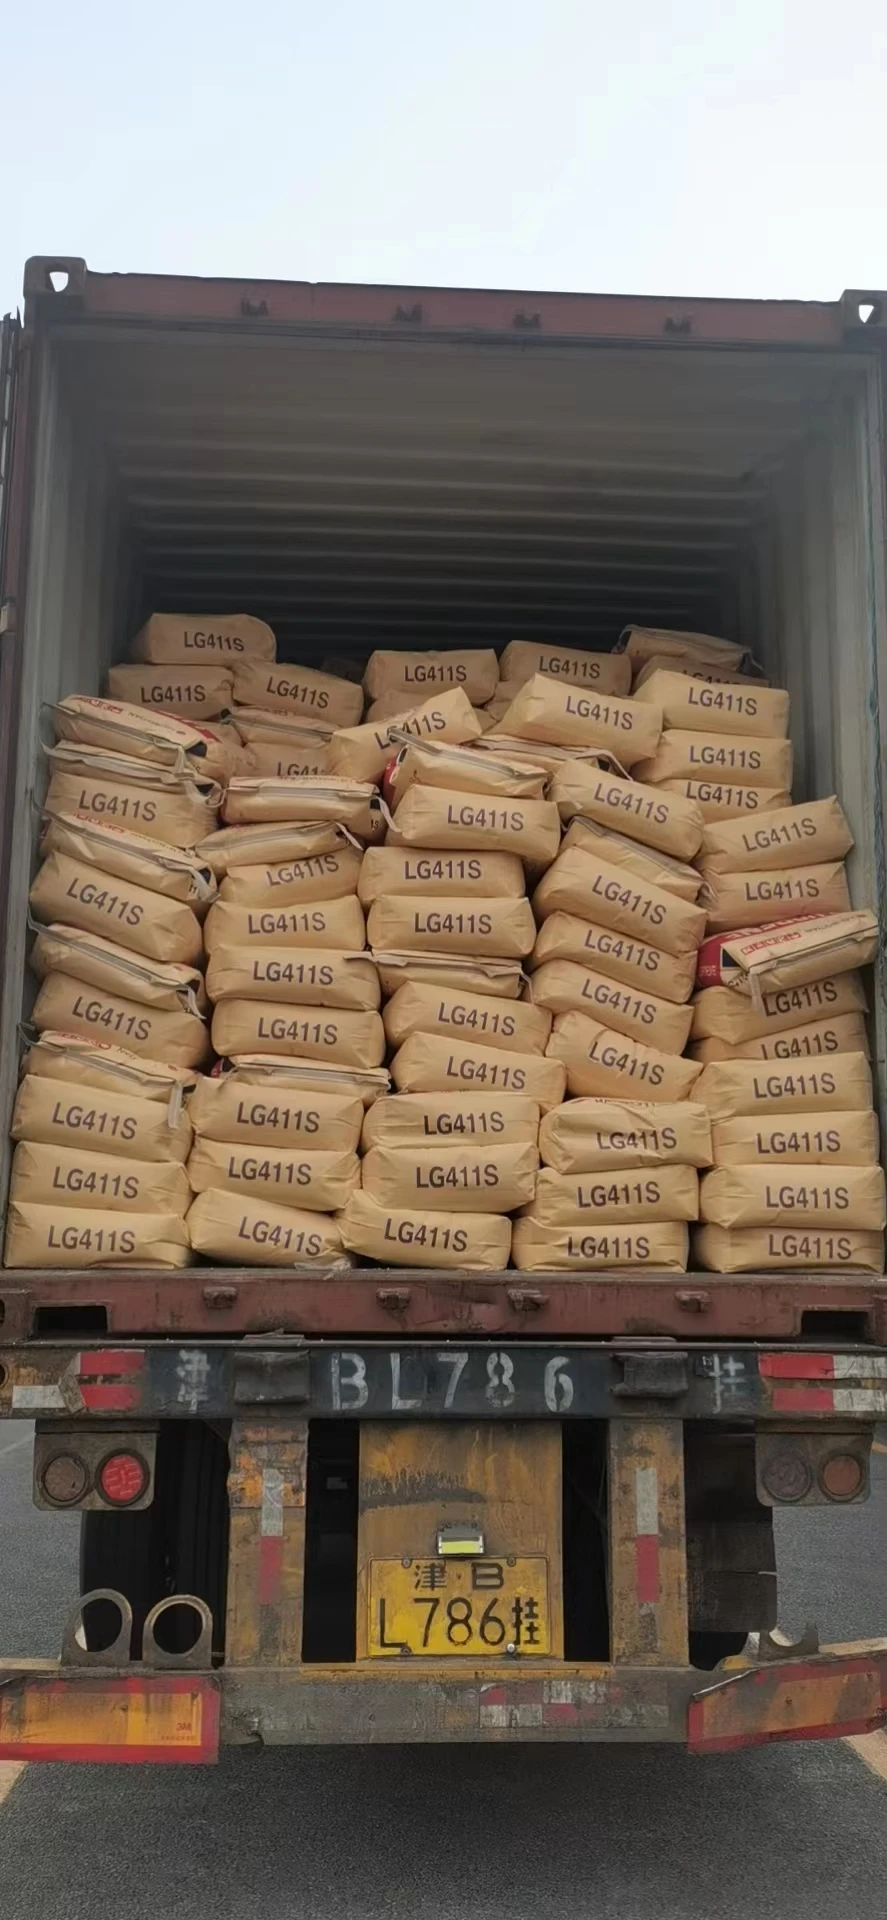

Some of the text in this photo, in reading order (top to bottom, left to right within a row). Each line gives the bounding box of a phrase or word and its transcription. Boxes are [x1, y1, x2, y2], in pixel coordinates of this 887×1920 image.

[184, 631, 245, 652] LG411S
[404, 665, 467, 682] LG411S
[538, 656, 601, 679] LG411S
[140, 685, 206, 703] LG411S
[266, 676, 330, 709] LG411S
[688, 687, 758, 716] LG411S
[566, 695, 633, 730] LG411S
[689, 745, 761, 769] LG411S
[78, 789, 157, 821] LG411S
[594, 783, 669, 824] LG411S
[686, 781, 759, 809] LG411S
[448, 804, 524, 831] LG411S
[742, 818, 817, 852] LG411S
[266, 854, 339, 887] LG411S
[404, 860, 482, 880] LG411S
[66, 877, 145, 926] LG411S
[592, 875, 667, 925] LG411S
[745, 878, 820, 902] LG411S
[248, 912, 326, 934] LG411S
[414, 912, 492, 934] LG411S
[584, 929, 660, 971] LG411S
[253, 961, 334, 985] LG411S
[581, 978, 657, 1024] LG411S
[762, 981, 838, 1017] LG411S
[72, 996, 152, 1040] LG411S
[257, 1017, 338, 1046] LG411S
[438, 1002, 516, 1036] LG411S
[446, 1056, 526, 1090] LG411S
[588, 1041, 664, 1085] LG411S
[753, 1072, 836, 1099] LG411S
[52, 1102, 137, 1140] LG411S
[236, 1102, 320, 1133] LG411S
[423, 1111, 504, 1135] LG411S
[596, 1127, 677, 1150] LG411S
[756, 1130, 841, 1154] LG411S
[52, 1166, 140, 1199] LG411S
[228, 1156, 312, 1186] LG411S
[416, 1164, 499, 1188] LG411S
[577, 1182, 661, 1208] LG411S
[765, 1185, 849, 1210] LG411S
[47, 1225, 136, 1254] LG411S
[238, 1217, 322, 1257] LG411S
[384, 1218, 468, 1252] LG411S
[567, 1236, 650, 1260] LG411S
[768, 1234, 852, 1260] LG411S
